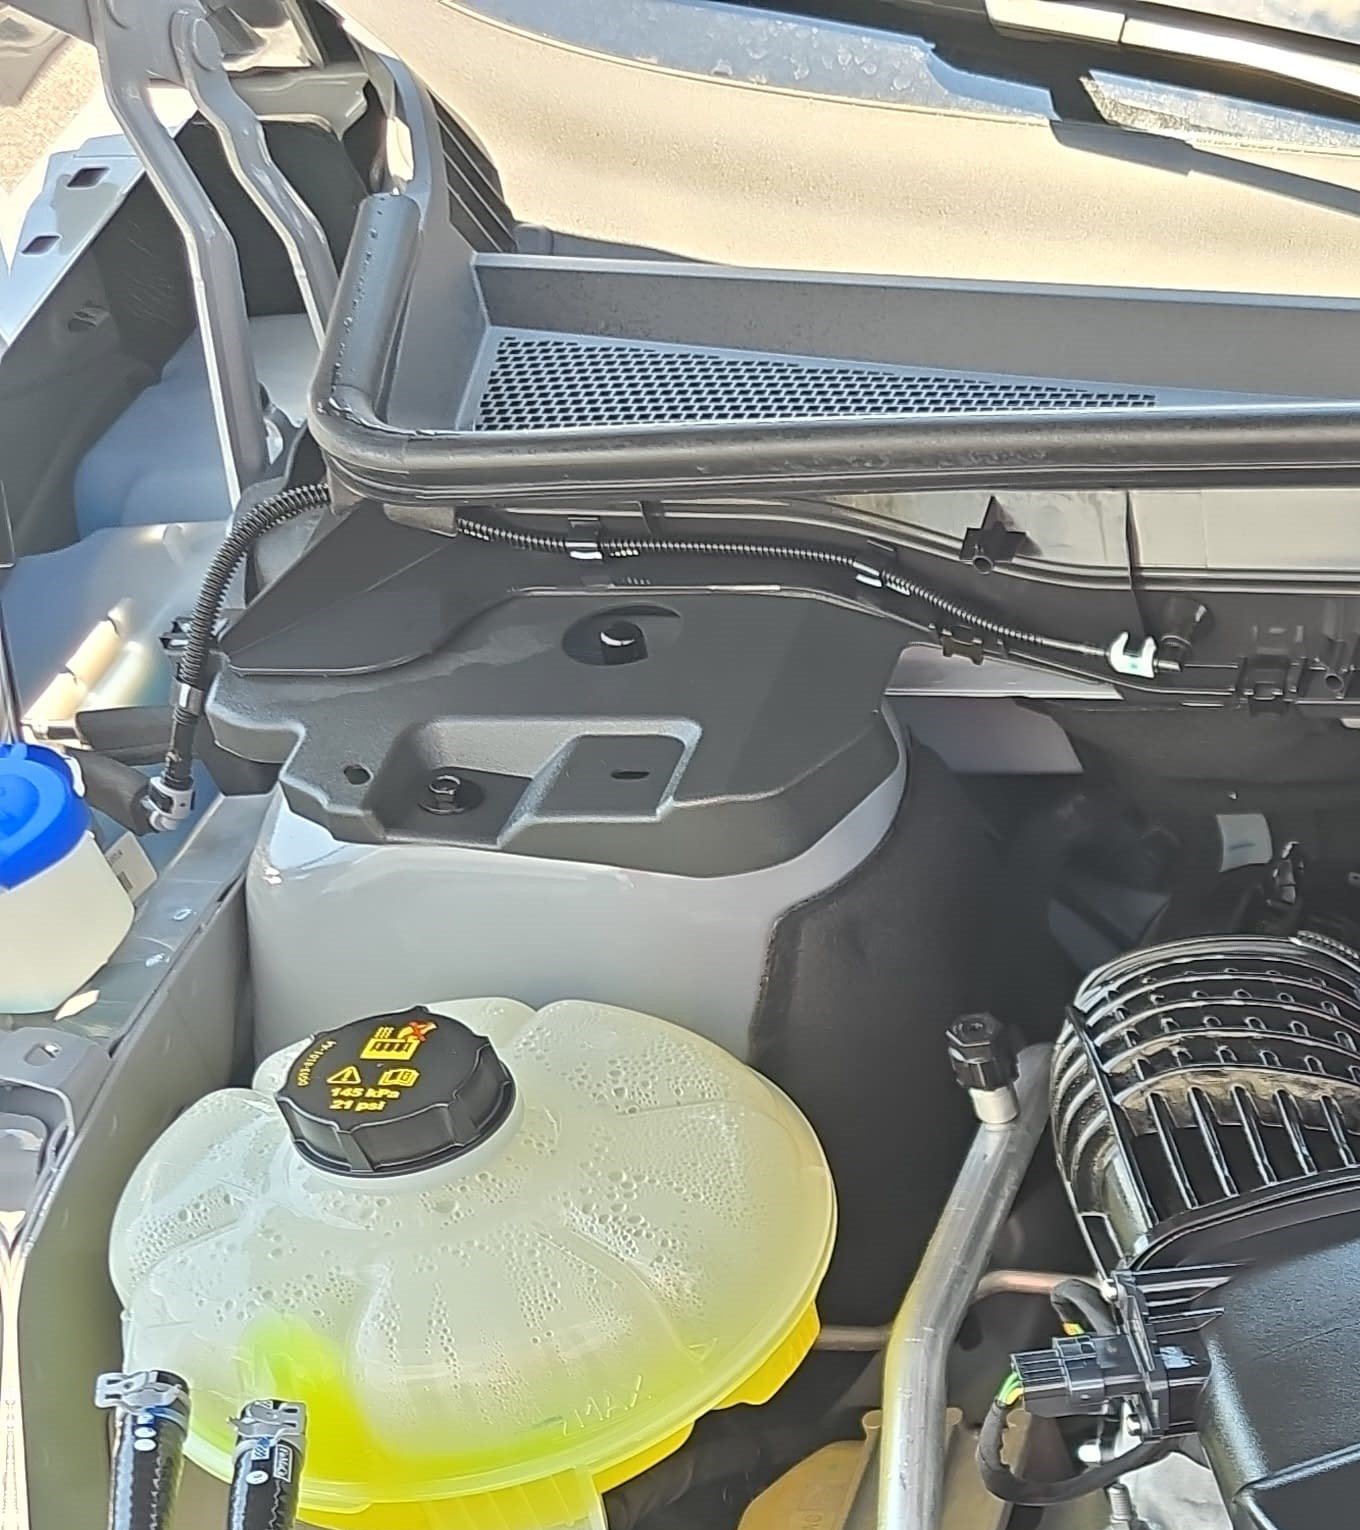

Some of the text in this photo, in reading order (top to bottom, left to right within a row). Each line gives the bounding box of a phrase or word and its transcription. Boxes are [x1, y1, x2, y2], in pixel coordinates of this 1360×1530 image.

[331, 1088, 401, 1098] 145 kPa
[329, 1100, 386, 1111] 21 psi
